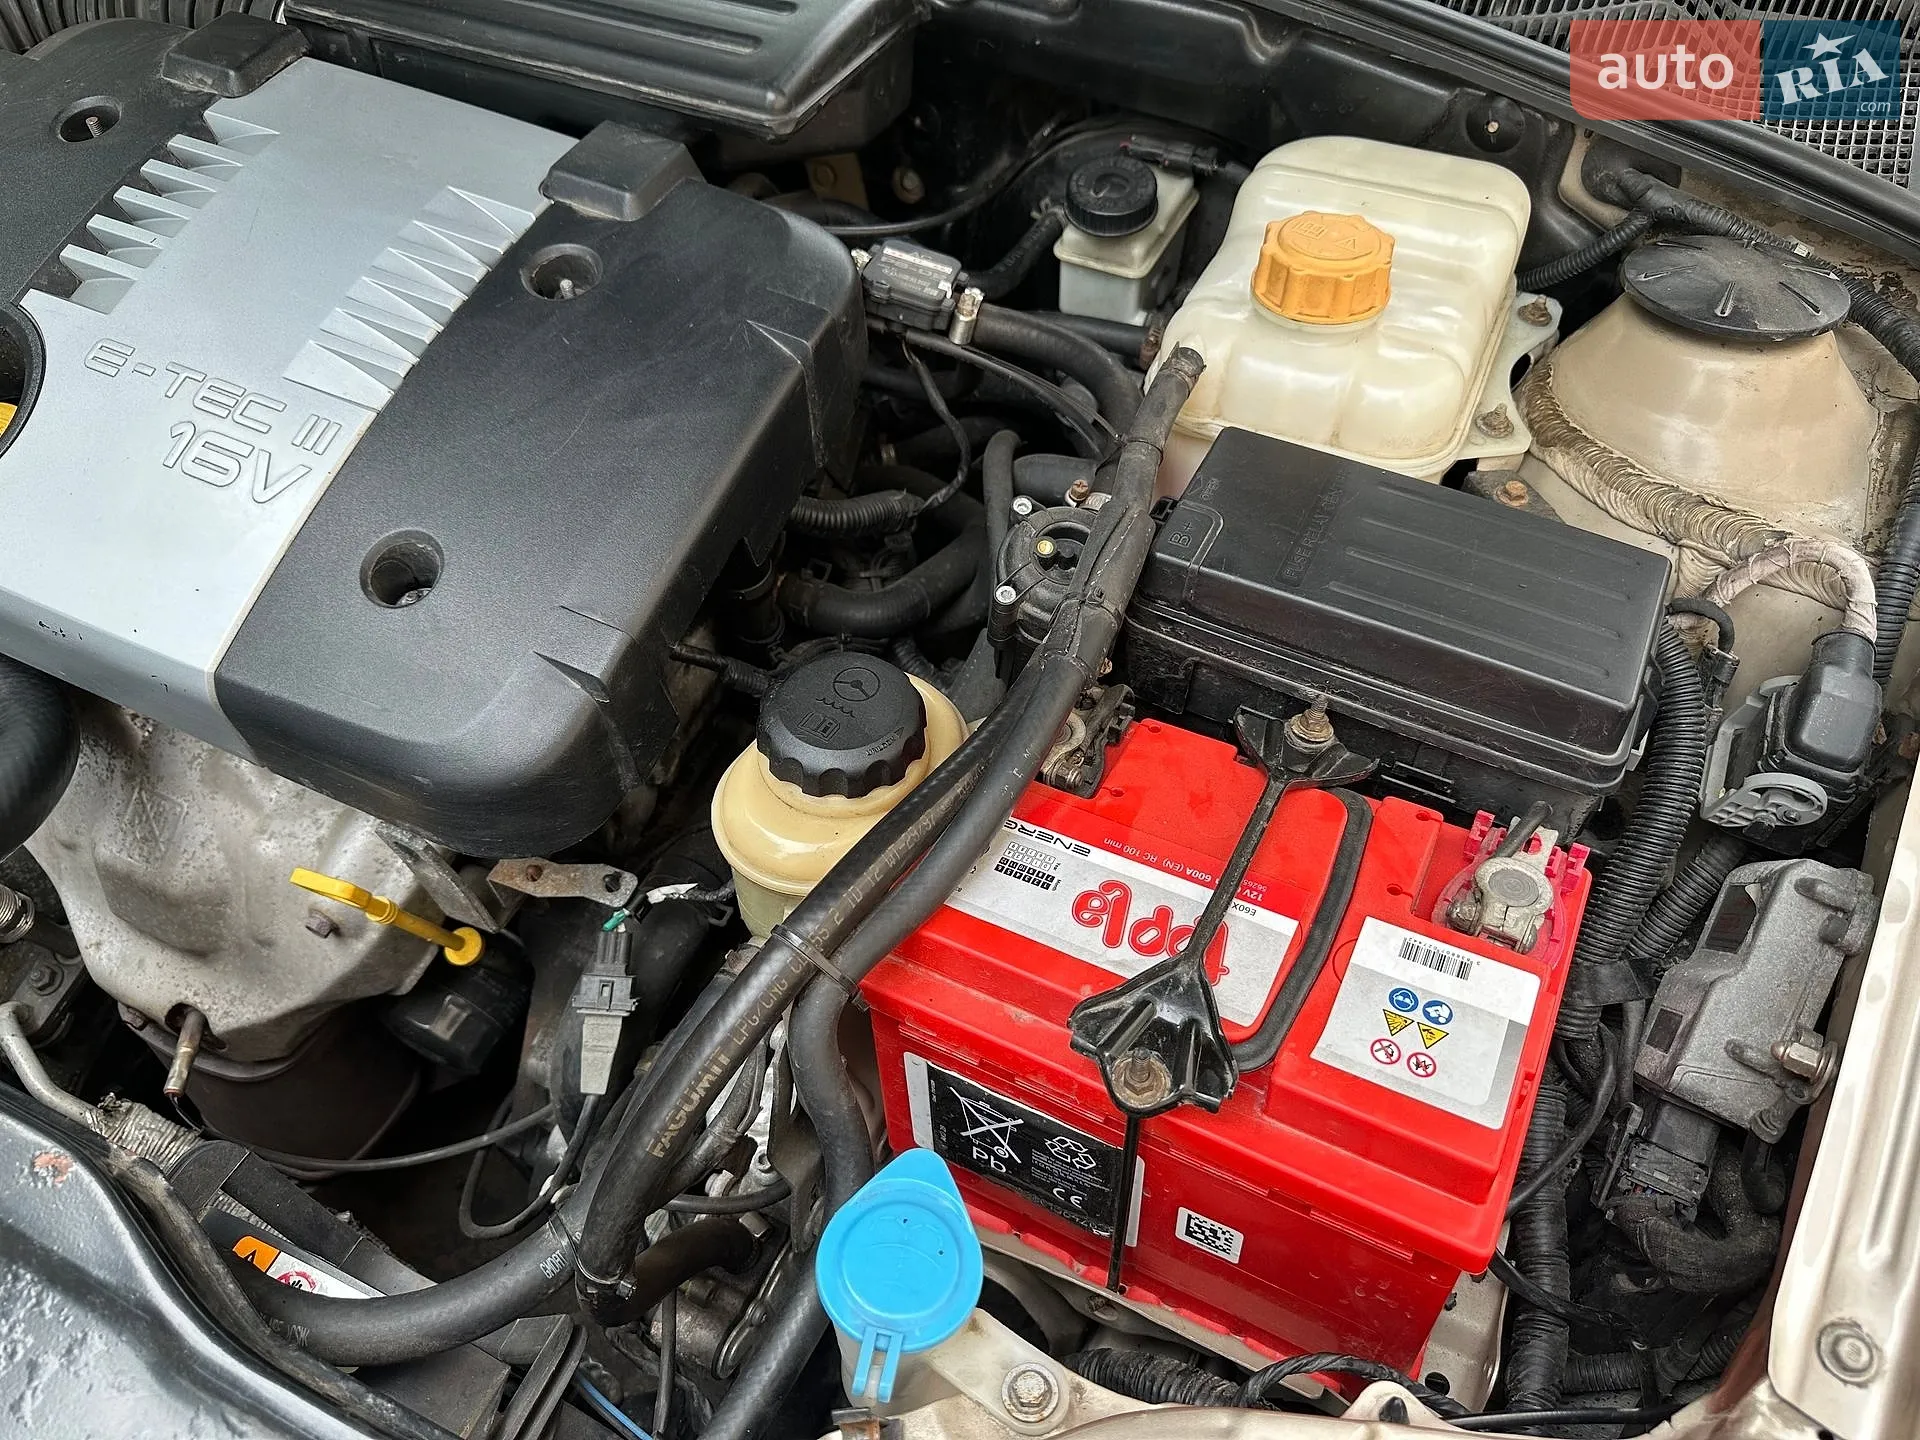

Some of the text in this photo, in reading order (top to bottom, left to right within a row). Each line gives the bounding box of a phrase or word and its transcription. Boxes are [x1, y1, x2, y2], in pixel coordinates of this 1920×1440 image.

[84, 338, 342, 456] E-TEC III
[163, 421, 312, 504] 16V
[1003, 819, 1091, 857] ENERG
[1104, 838, 1263, 902] 12V 600A (EN) RC 100 min
[1072, 880, 1230, 986] topla
[646, 1047, 731, 1158] FAGUMIT
[732, 974, 788, 1046] LPG/CNG
[829, 907, 844, 925] 2
[972, 1147, 1007, 1173] Pb
[1052, 1187, 1083, 1208] CE
